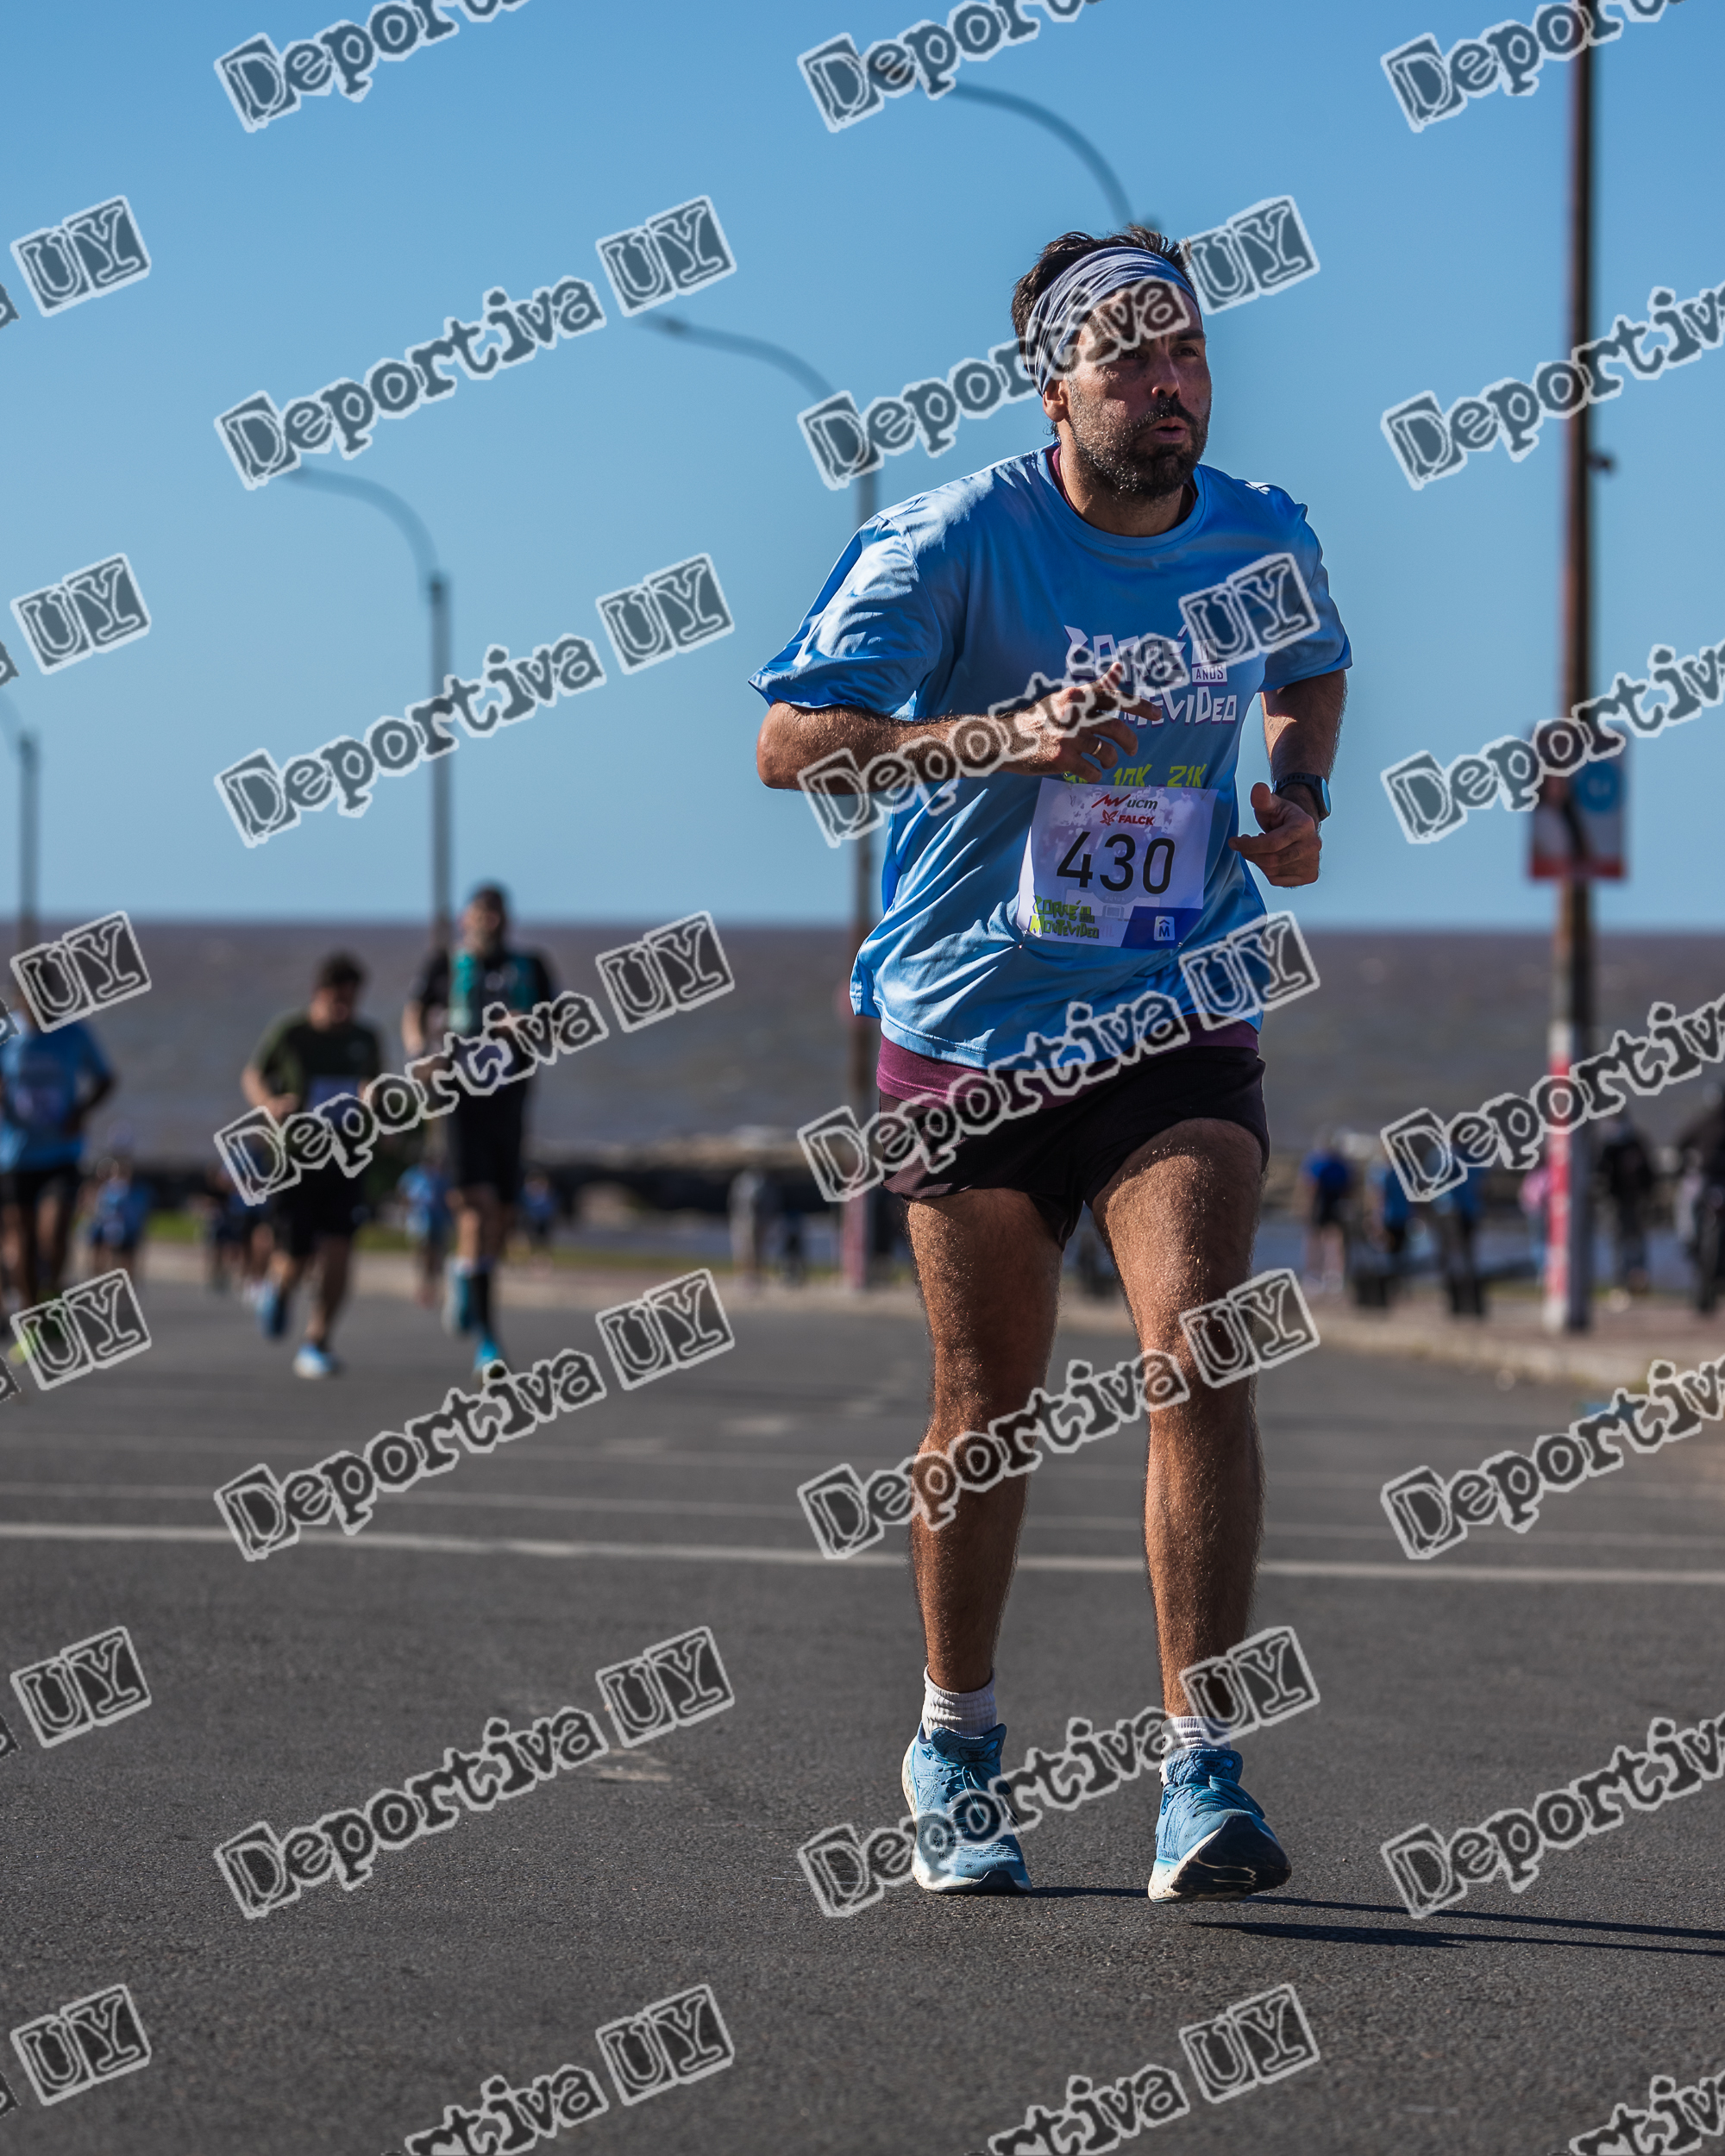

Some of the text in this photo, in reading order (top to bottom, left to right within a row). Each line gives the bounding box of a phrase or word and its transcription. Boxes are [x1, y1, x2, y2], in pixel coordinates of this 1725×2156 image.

[1167, 764, 1208, 787] 21K
[1126, 799, 1158, 810] ucm
[1118, 814, 1156, 826] FALCK
[1056, 830, 1176, 894] 430
[1027, 915, 1100, 939] MONTEVIDEO
